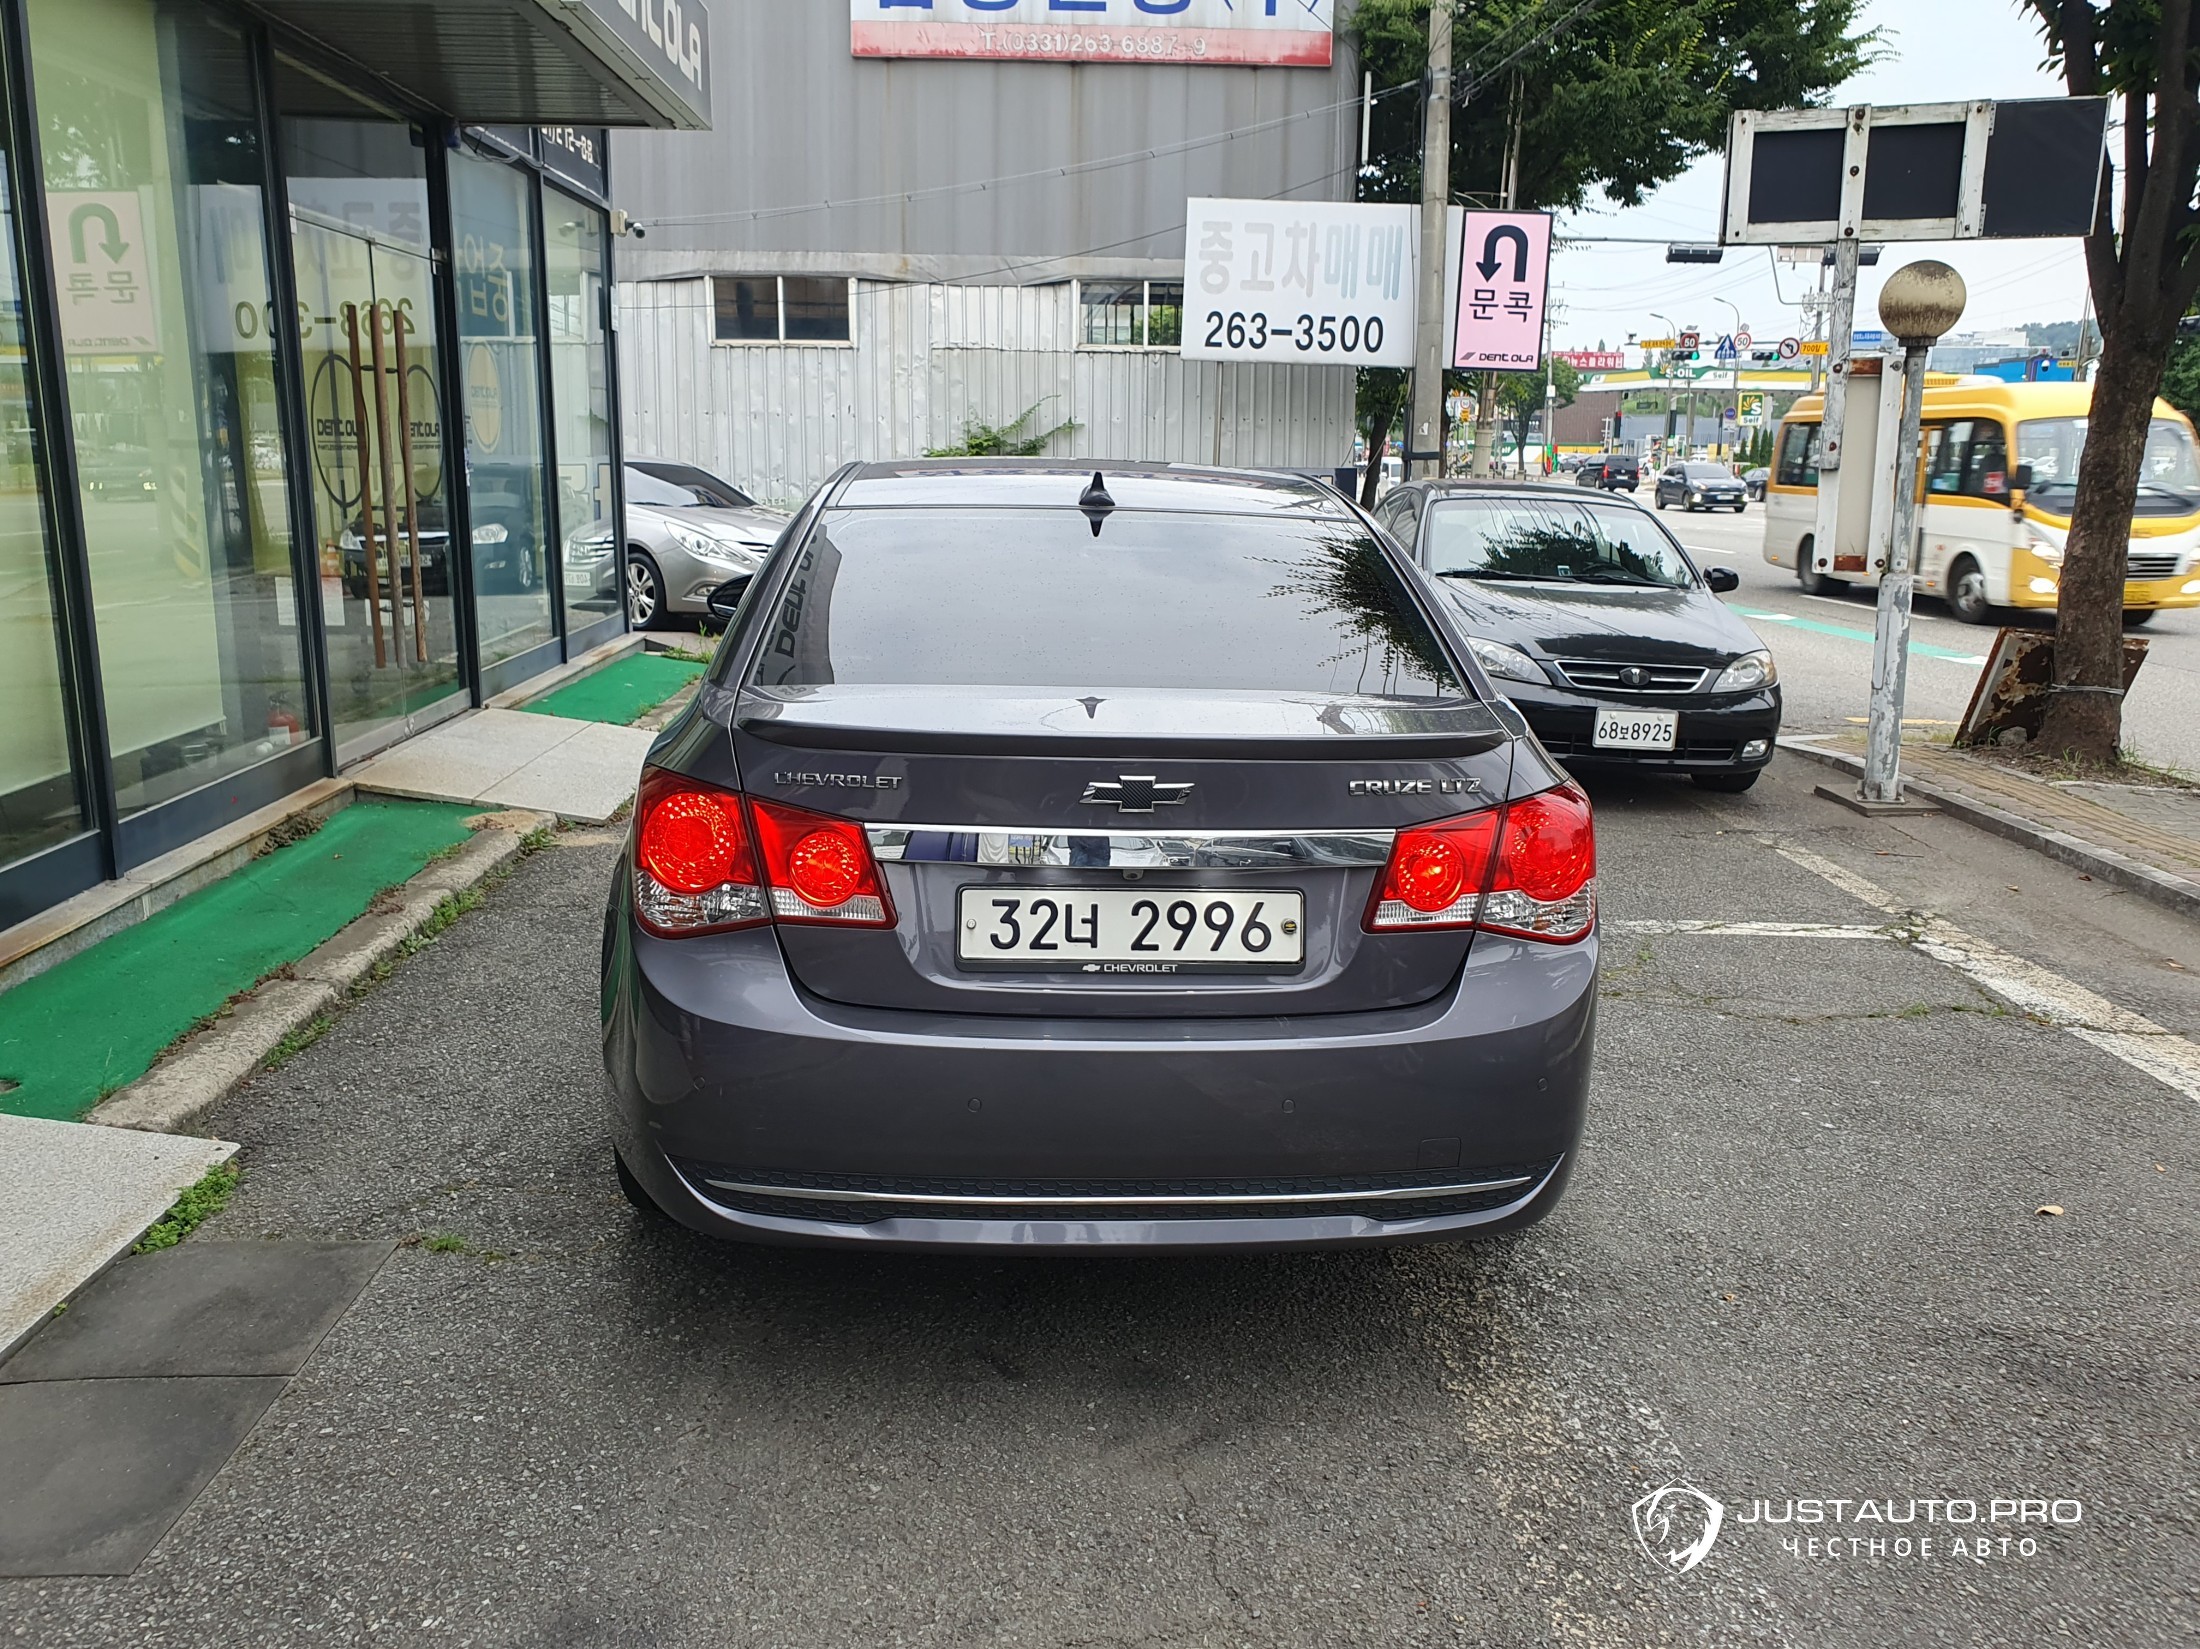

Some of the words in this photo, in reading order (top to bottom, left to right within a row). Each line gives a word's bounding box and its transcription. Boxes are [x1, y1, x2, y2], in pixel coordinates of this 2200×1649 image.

[1198, 220, 1403, 301] 중고차매매
[1469, 288, 1534, 324] 문콕
[1204, 310, 1385, 353] 263-3500
[1684, 337, 1696, 348] 50
[1737, 337, 1749, 347] 50
[1713, 371, 1728, 379] Self
[773, 771, 903, 790] CHEVROLET
[1349, 779, 1432, 797] CRUZE
[1440, 777, 1481, 794] LTZ
[990, 898, 1098, 950] 32너
[1130, 899, 1272, 953] 2996
[1104, 963, 1178, 973] CHEVROLET
